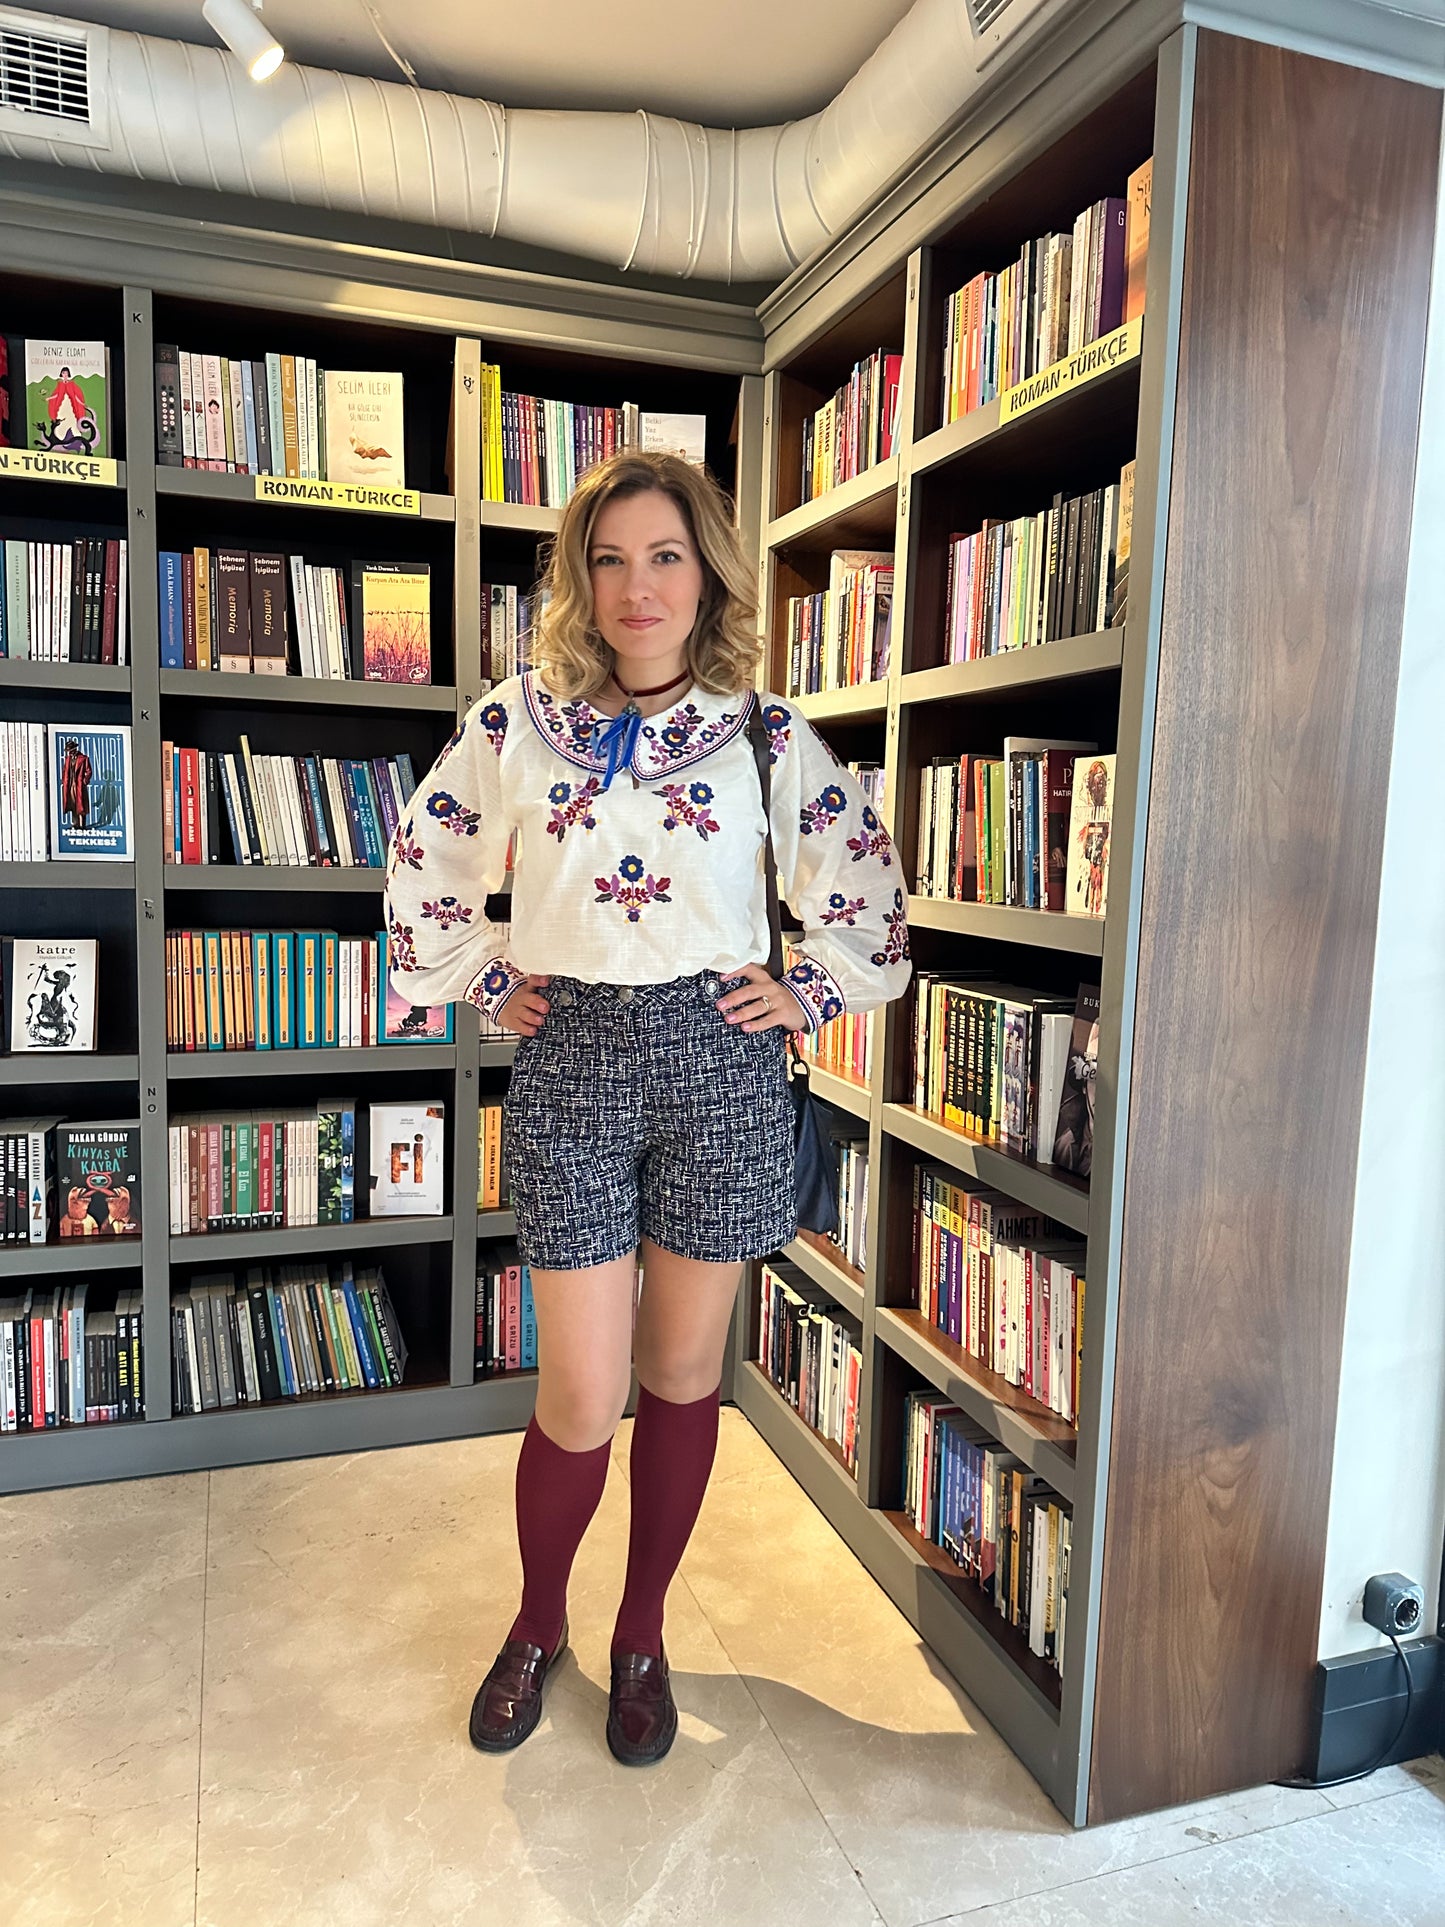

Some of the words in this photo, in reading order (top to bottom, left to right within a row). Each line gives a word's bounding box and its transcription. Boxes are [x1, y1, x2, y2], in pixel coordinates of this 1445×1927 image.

[133, 313, 142, 323] K
[1010, 371, 1060, 412] ROMAN
[263, 481, 333, 500] ROMAN
[136, 506, 146, 518] K
[219, 555, 246, 564] Şebnem
[254, 558, 280, 567] Şebnem
[227, 586, 239, 634] Memoria
[263, 589, 274, 636] Memoria
[141, 710, 150, 721] K
[62, 827, 123, 838] MİSKİNLER
[69, 837, 117, 847] TEKKESİ
[36, 945, 76, 955] katre
[977, 1020, 985, 1044] BUKET
[957, 1039, 965, 1066] UZUNER
[967, 1042, 975, 1069] UZUNER
[976, 1045, 984, 1073] UZUNER
[465, 1070, 472, 1079] S
[147, 1087, 156, 1096] N
[147, 1104, 156, 1113] O
[68, 1133, 95, 1143] HAKAN
[97, 1132, 128, 1143] GÜNDAY
[67, 1144, 110, 1160] KİNYAS
[115, 1146, 129, 1158] VE
[391, 1133, 424, 1184] Fi
[32, 1158, 40, 1180] GÜNDAY
[81, 1158, 121, 1175] KAYRA
[510, 1305, 516, 1313] 2
[526, 1304, 533, 1313] 3
